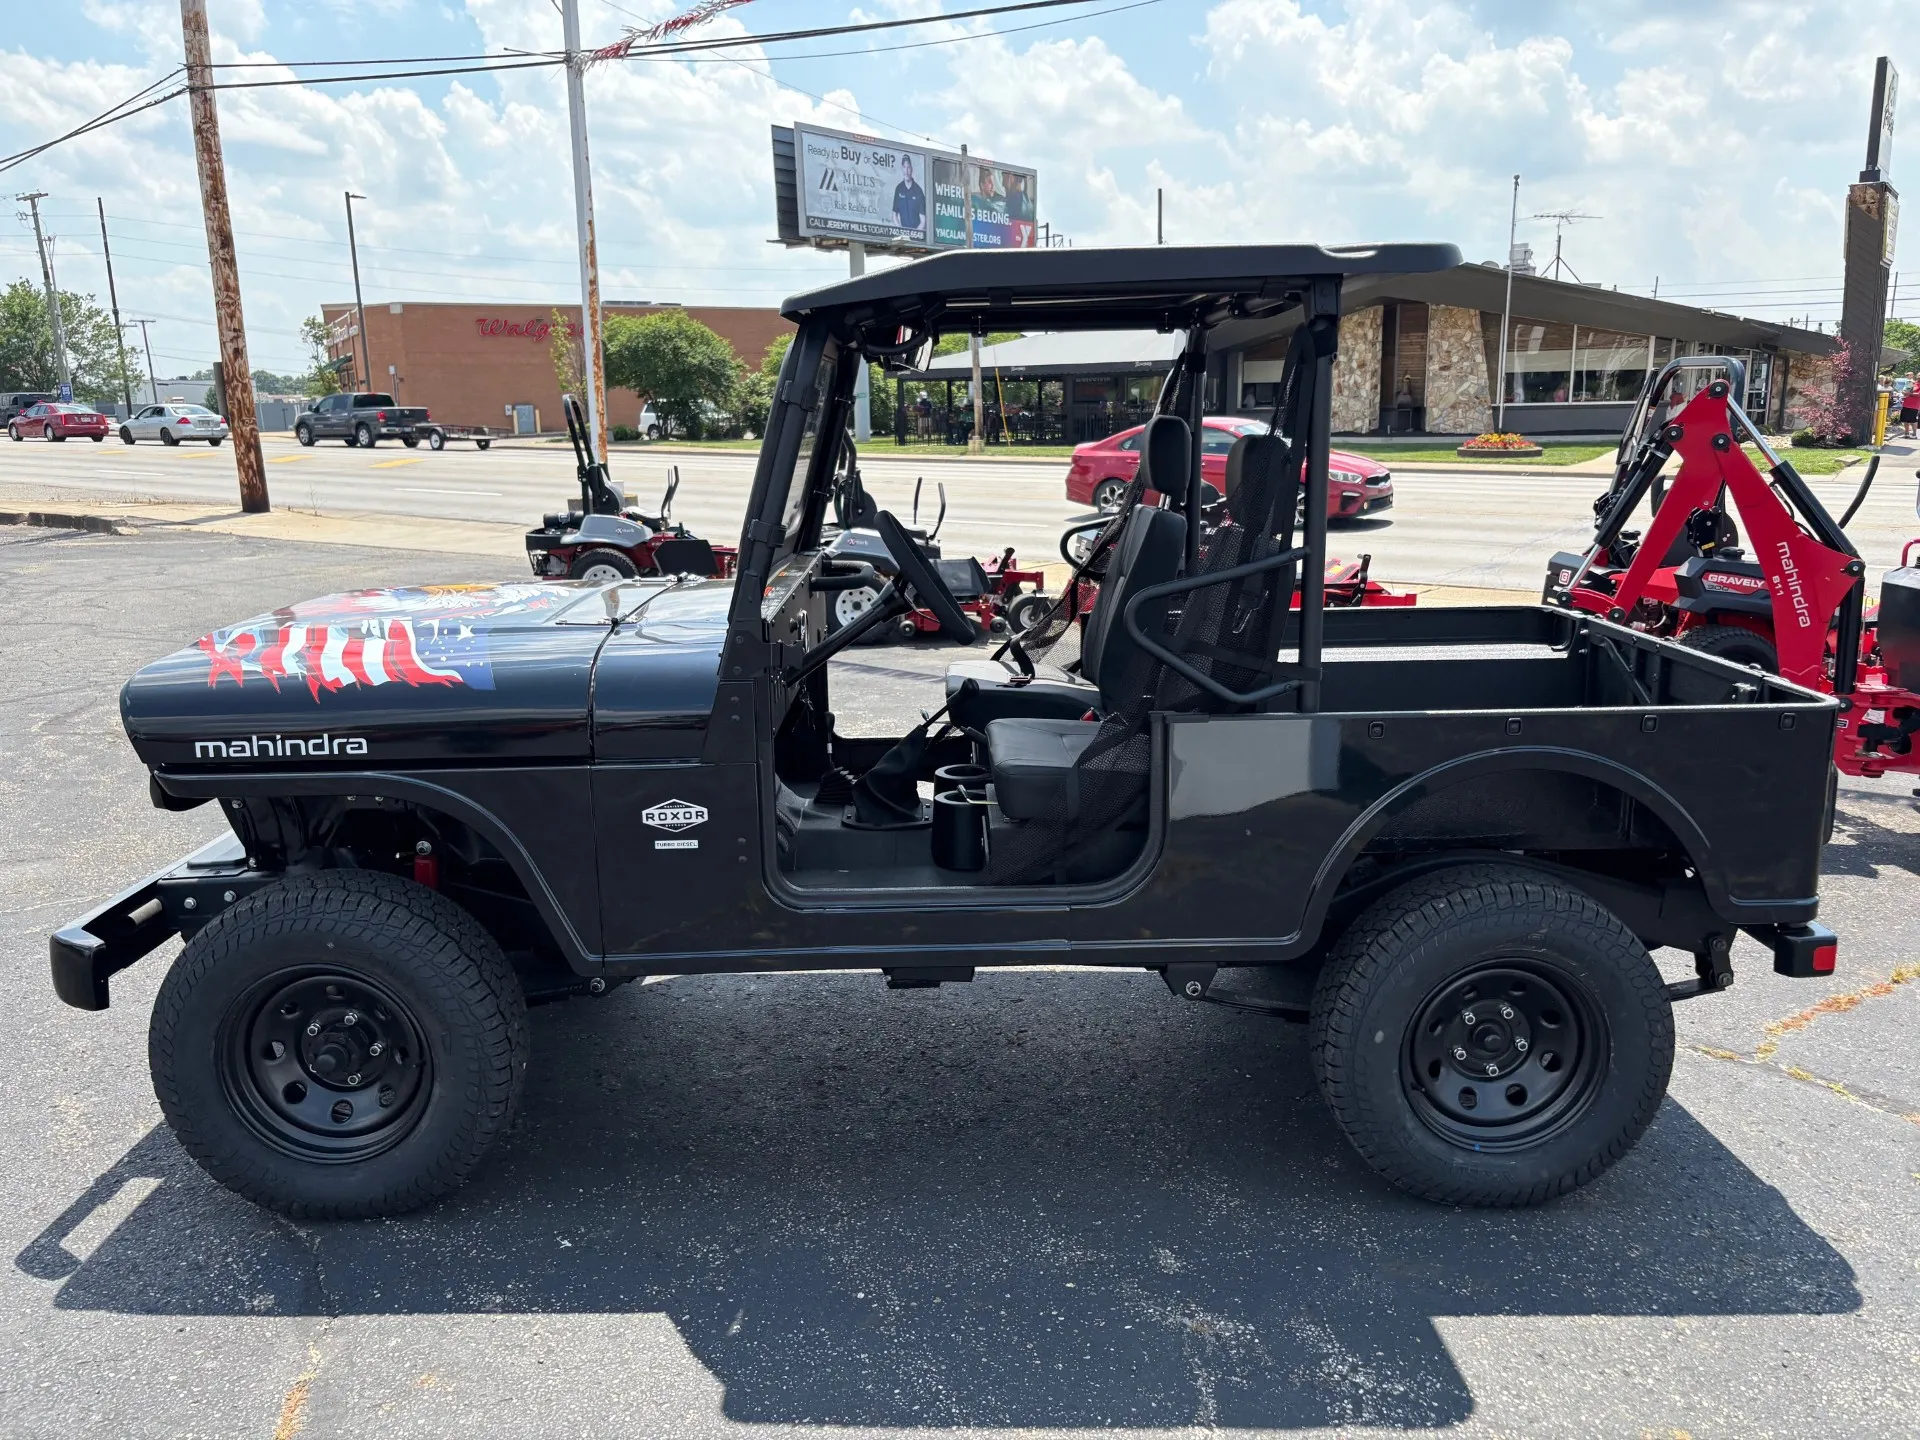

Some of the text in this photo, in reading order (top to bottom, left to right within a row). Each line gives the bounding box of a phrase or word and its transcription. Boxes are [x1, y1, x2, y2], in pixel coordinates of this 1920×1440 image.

[808, 144, 896, 168] Ready to Buy or Sell?
[843, 172, 876, 188] MILLS
[848, 202, 867, 215] Realty
[935, 202, 1012, 226] FAMILIS BELONG.
[809, 217, 826, 228] CALL
[826, 220, 850, 231] JEREMY
[850, 223, 867, 233] MILLS
[867, 225, 889, 235] TODAY!
[1707, 573, 1765, 588] GRAVELY
[1776, 541, 1811, 628] mahindra
[195, 733, 368, 758] mahindra
[645, 810, 705, 822] ROXOR
